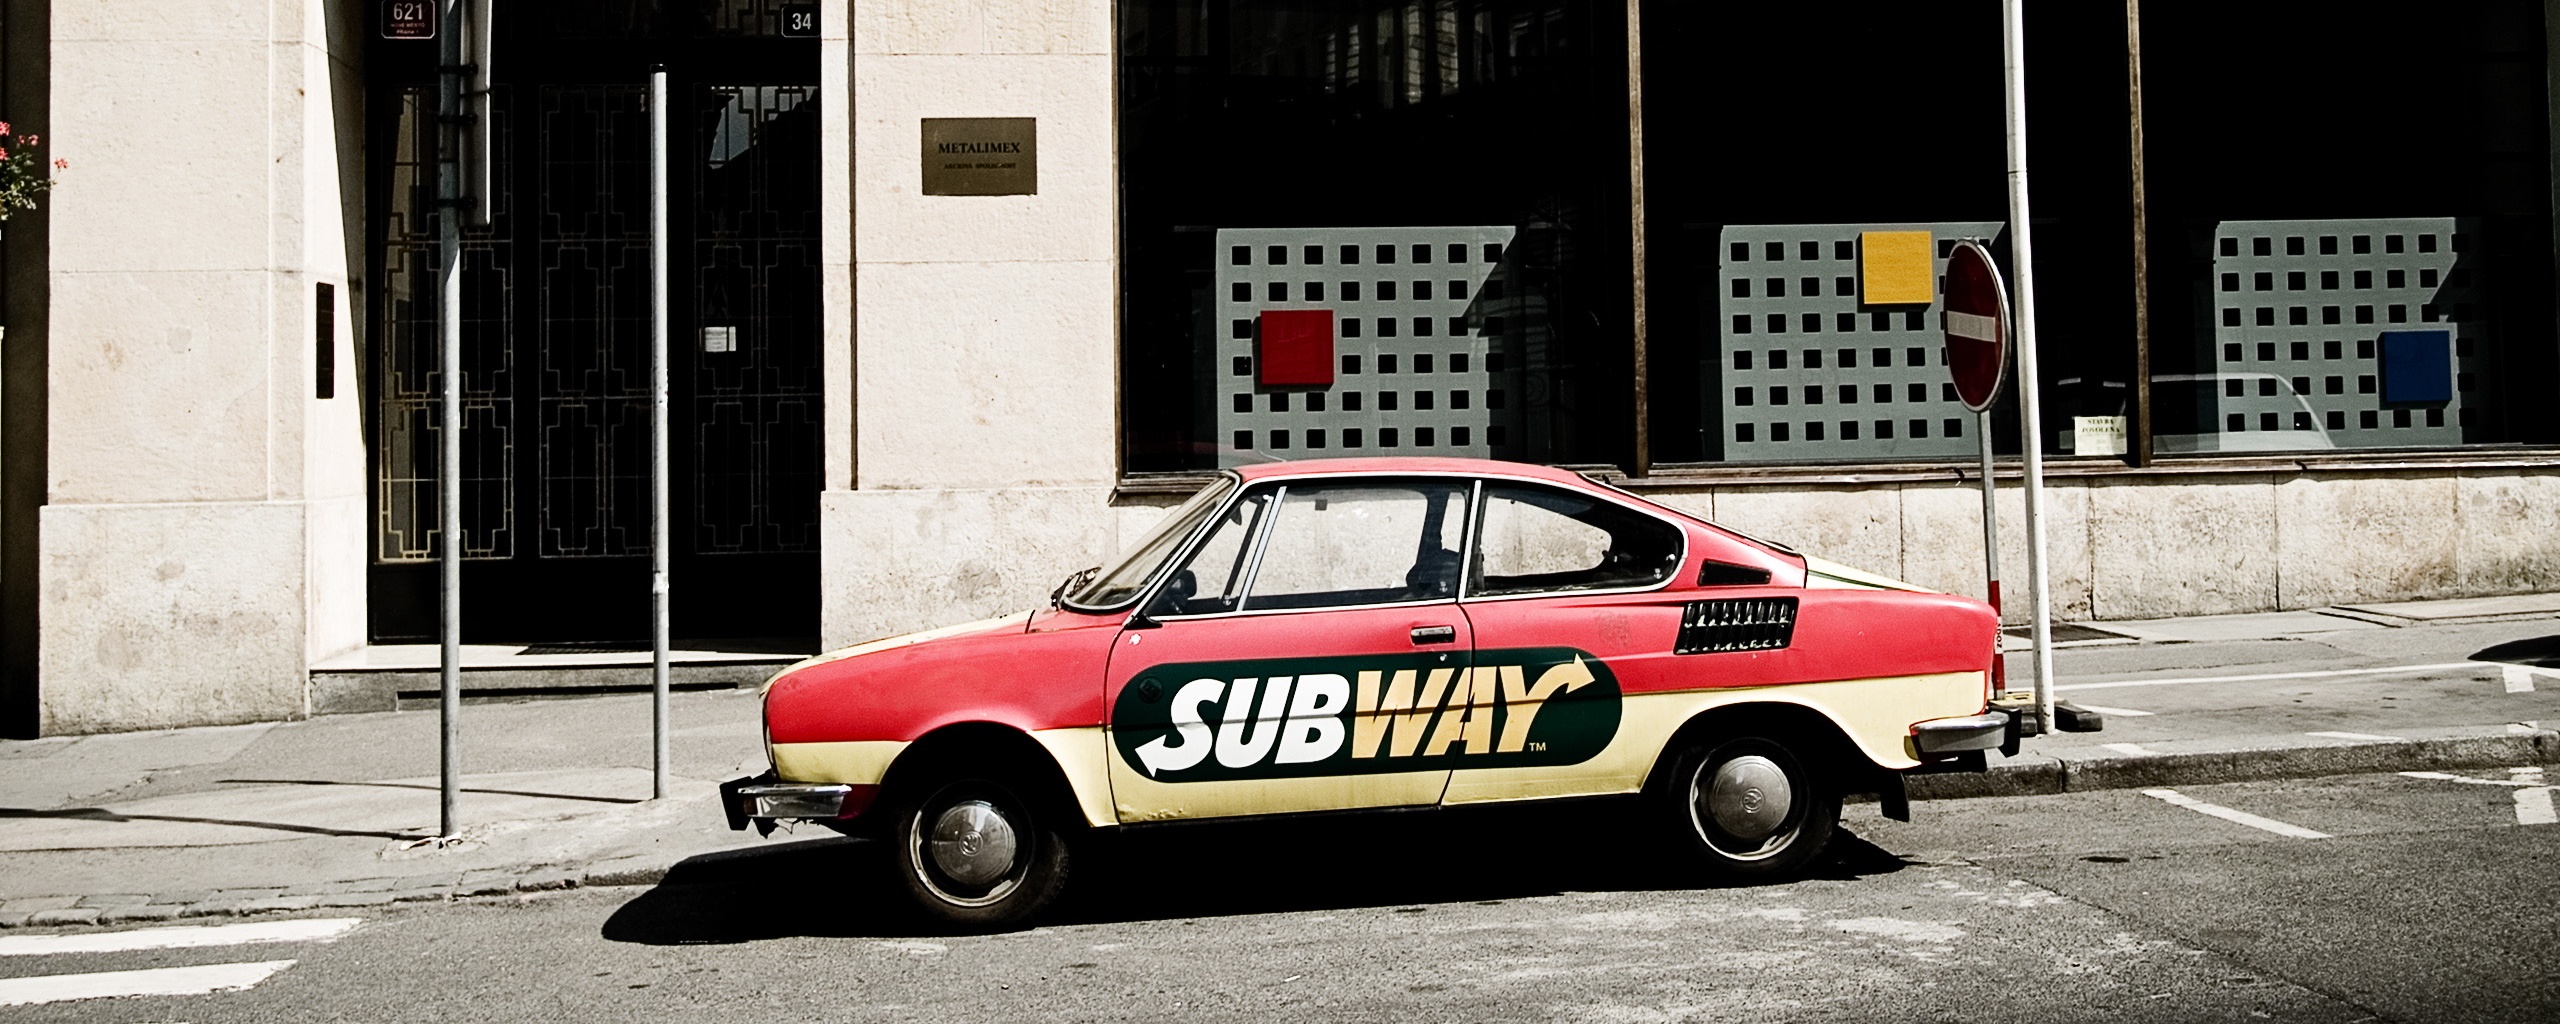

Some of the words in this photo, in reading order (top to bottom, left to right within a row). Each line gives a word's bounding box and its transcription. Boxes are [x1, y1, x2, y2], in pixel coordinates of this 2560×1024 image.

[393, 3, 422, 20] 621
[792, 13, 811, 30] 34
[939, 142, 1020, 154] METALIMEX
[1135, 654, 1596, 777] SUBWAY
[1529, 742, 1546, 751] TM
